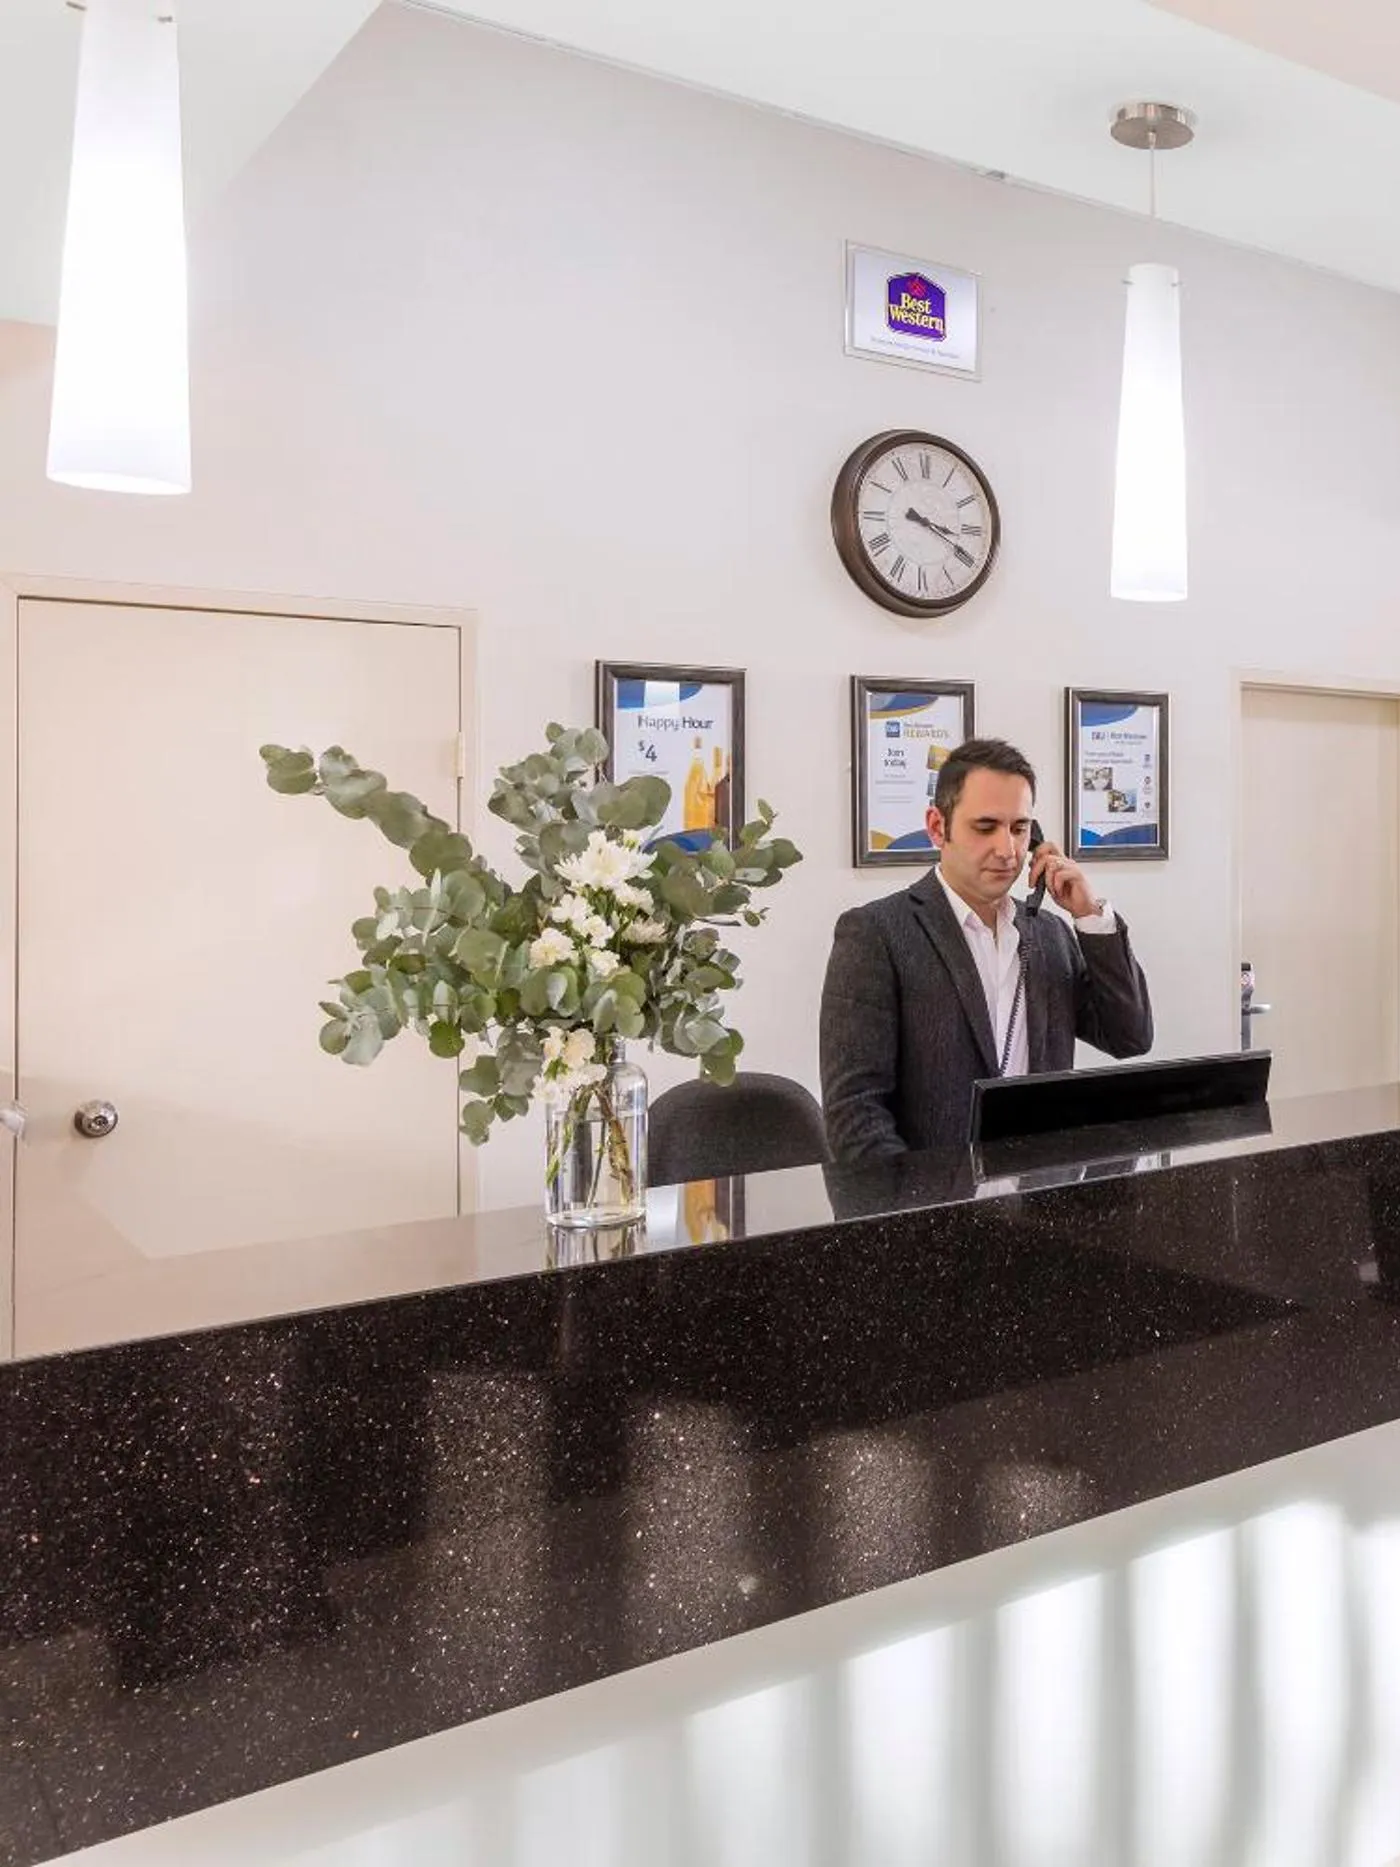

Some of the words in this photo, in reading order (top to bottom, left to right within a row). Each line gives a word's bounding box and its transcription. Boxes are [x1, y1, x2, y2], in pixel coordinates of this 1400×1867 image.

[901, 293, 932, 314] Best
[889, 304, 944, 331] Western
[637, 715, 680, 732] Happy
[682, 716, 714, 729] Hour
